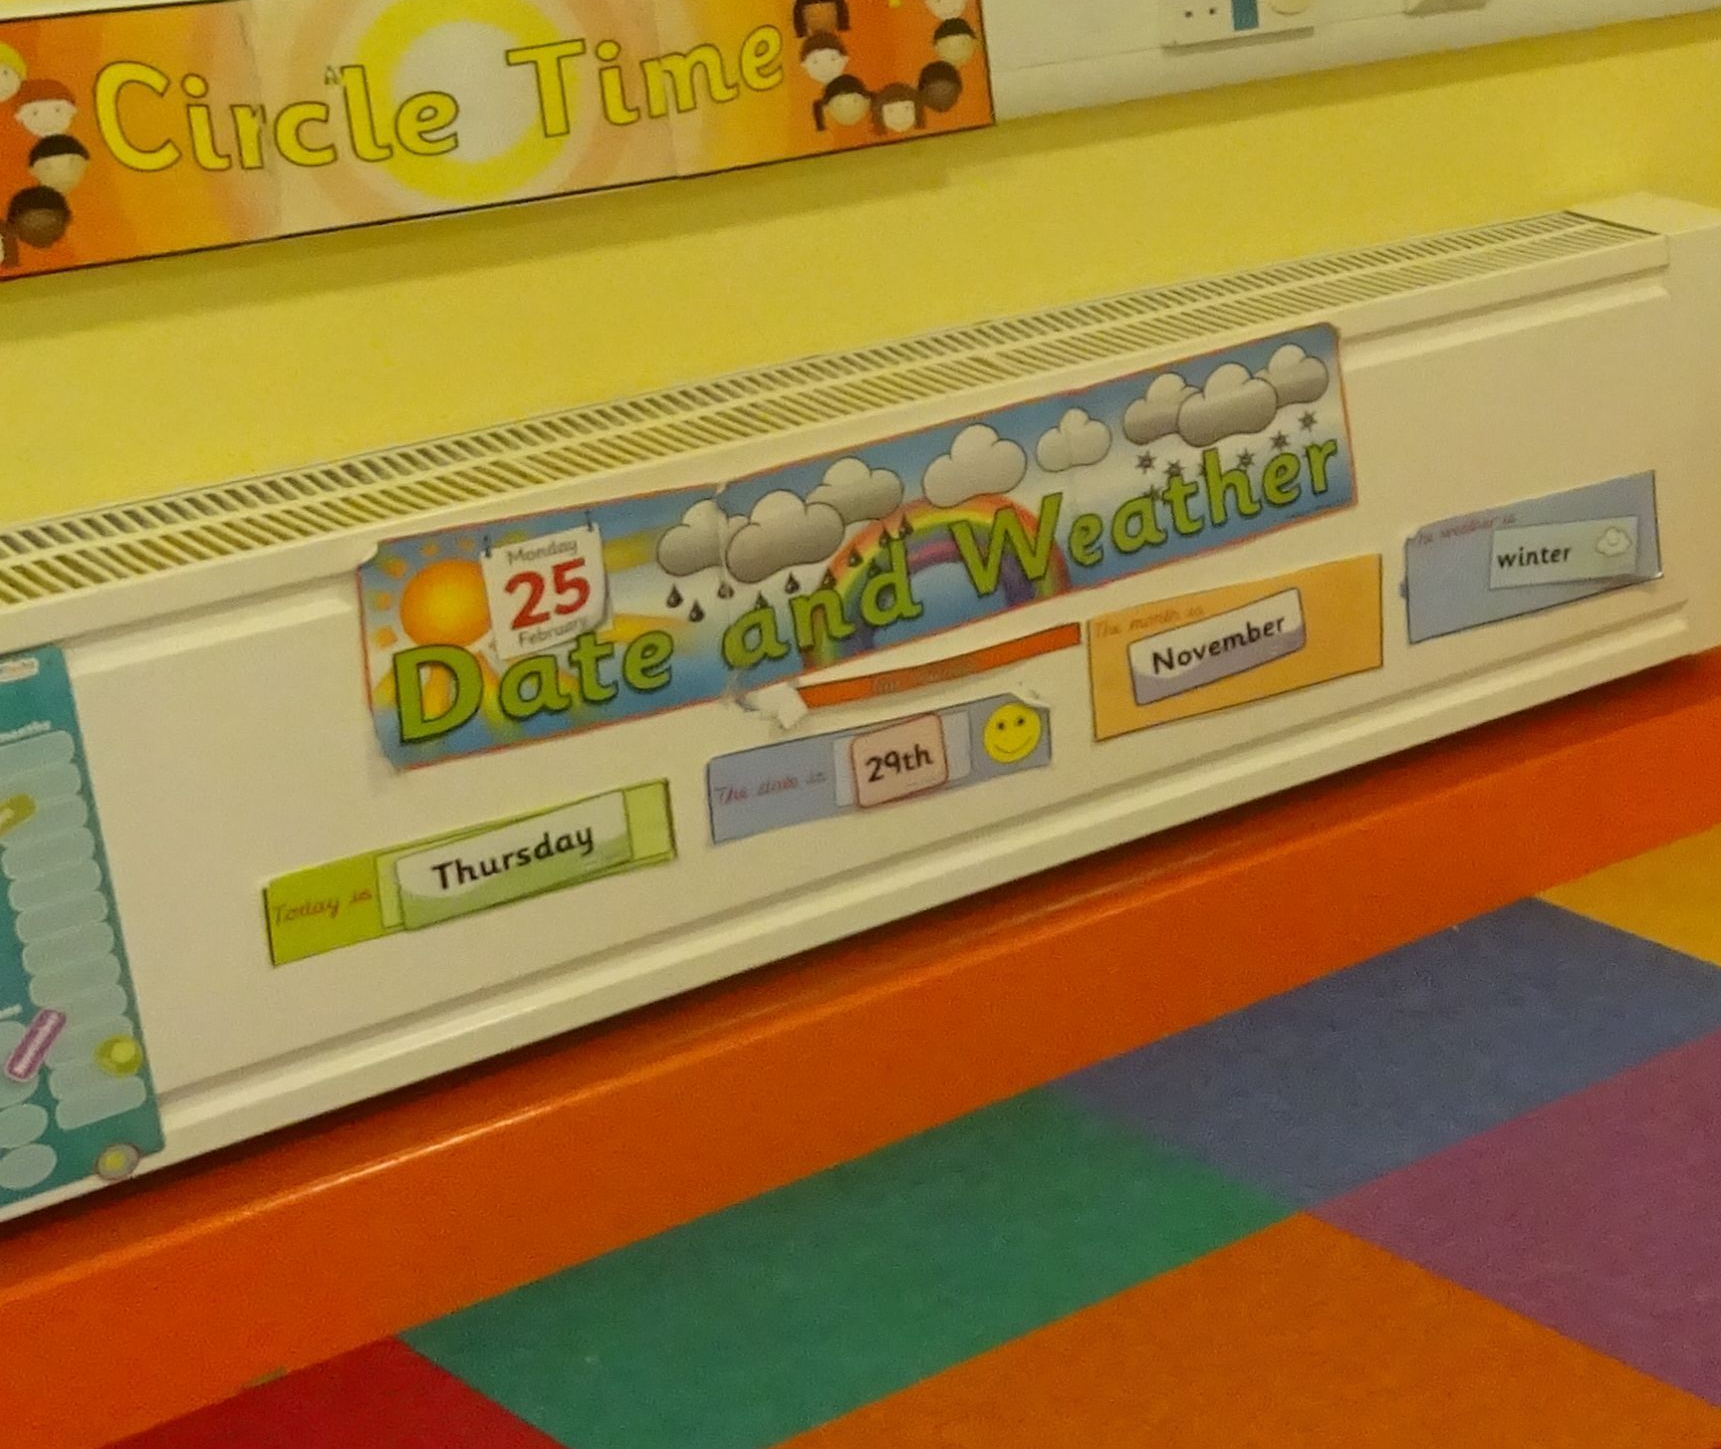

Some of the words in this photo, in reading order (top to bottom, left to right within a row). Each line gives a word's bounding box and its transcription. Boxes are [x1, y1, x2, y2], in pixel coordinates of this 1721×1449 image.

[93, 59, 460, 173] Circle
[505, 23, 787, 139] Time
[506, 538, 578, 566] Monday
[1497, 546, 1573, 569] winter
[392, 630, 674, 744] Date
[721, 538, 924, 670] and
[948, 438, 1340, 599] Weather
[504, 557, 591, 630] 25
[517, 616, 588, 648] February
[1152, 614, 1286, 674] November
[865, 742, 934, 783] 29th
[431, 826, 595, 892] Thursday
[271, 896, 341, 927] Today
[348, 888, 374, 906] is
